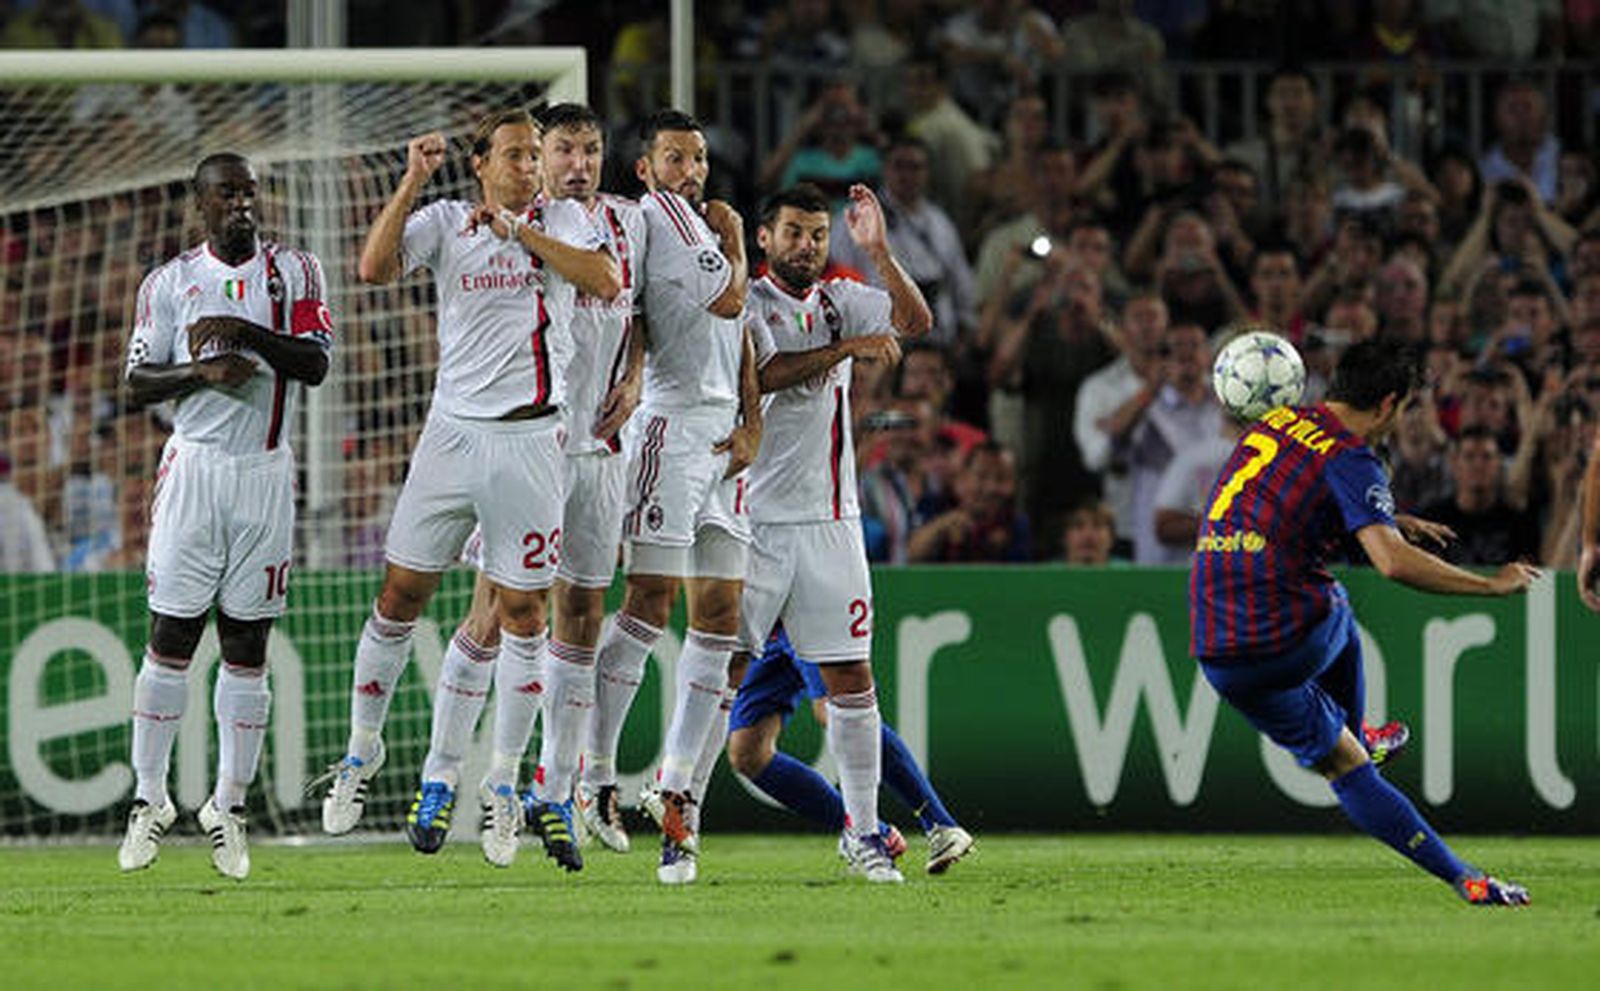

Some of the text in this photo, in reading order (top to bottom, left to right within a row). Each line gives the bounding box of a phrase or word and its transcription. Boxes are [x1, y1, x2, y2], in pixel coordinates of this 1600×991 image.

[461, 271, 547, 292] Emirates
[1208, 432, 1279, 521] 7
[849, 599, 869, 639] 2
[1048, 568, 1600, 809] worl
